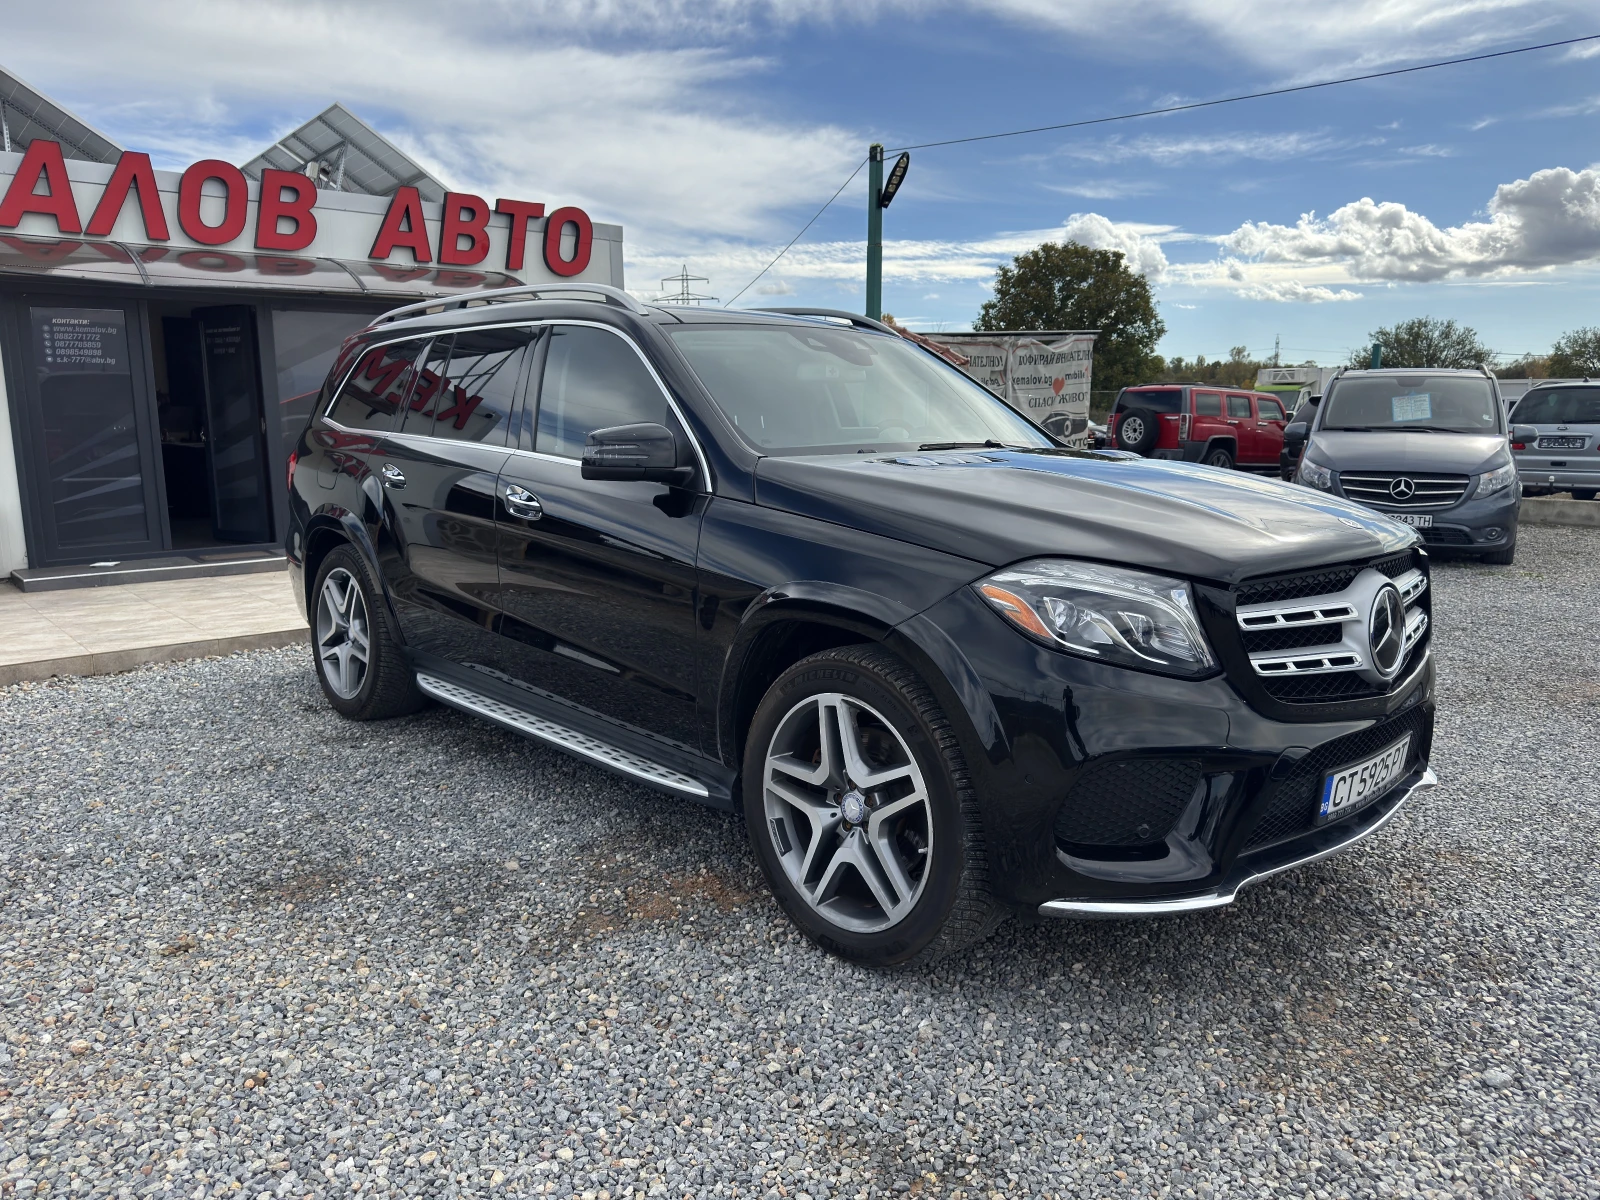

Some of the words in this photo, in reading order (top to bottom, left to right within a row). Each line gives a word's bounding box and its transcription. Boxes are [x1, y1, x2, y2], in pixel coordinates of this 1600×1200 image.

[368, 185, 593, 277] АВТО
[1320, 802, 1329, 813] BG
[1333, 770, 1358, 808] CT
[1357, 752, 1392, 796] 5925
[1390, 741, 1408, 777] PT
